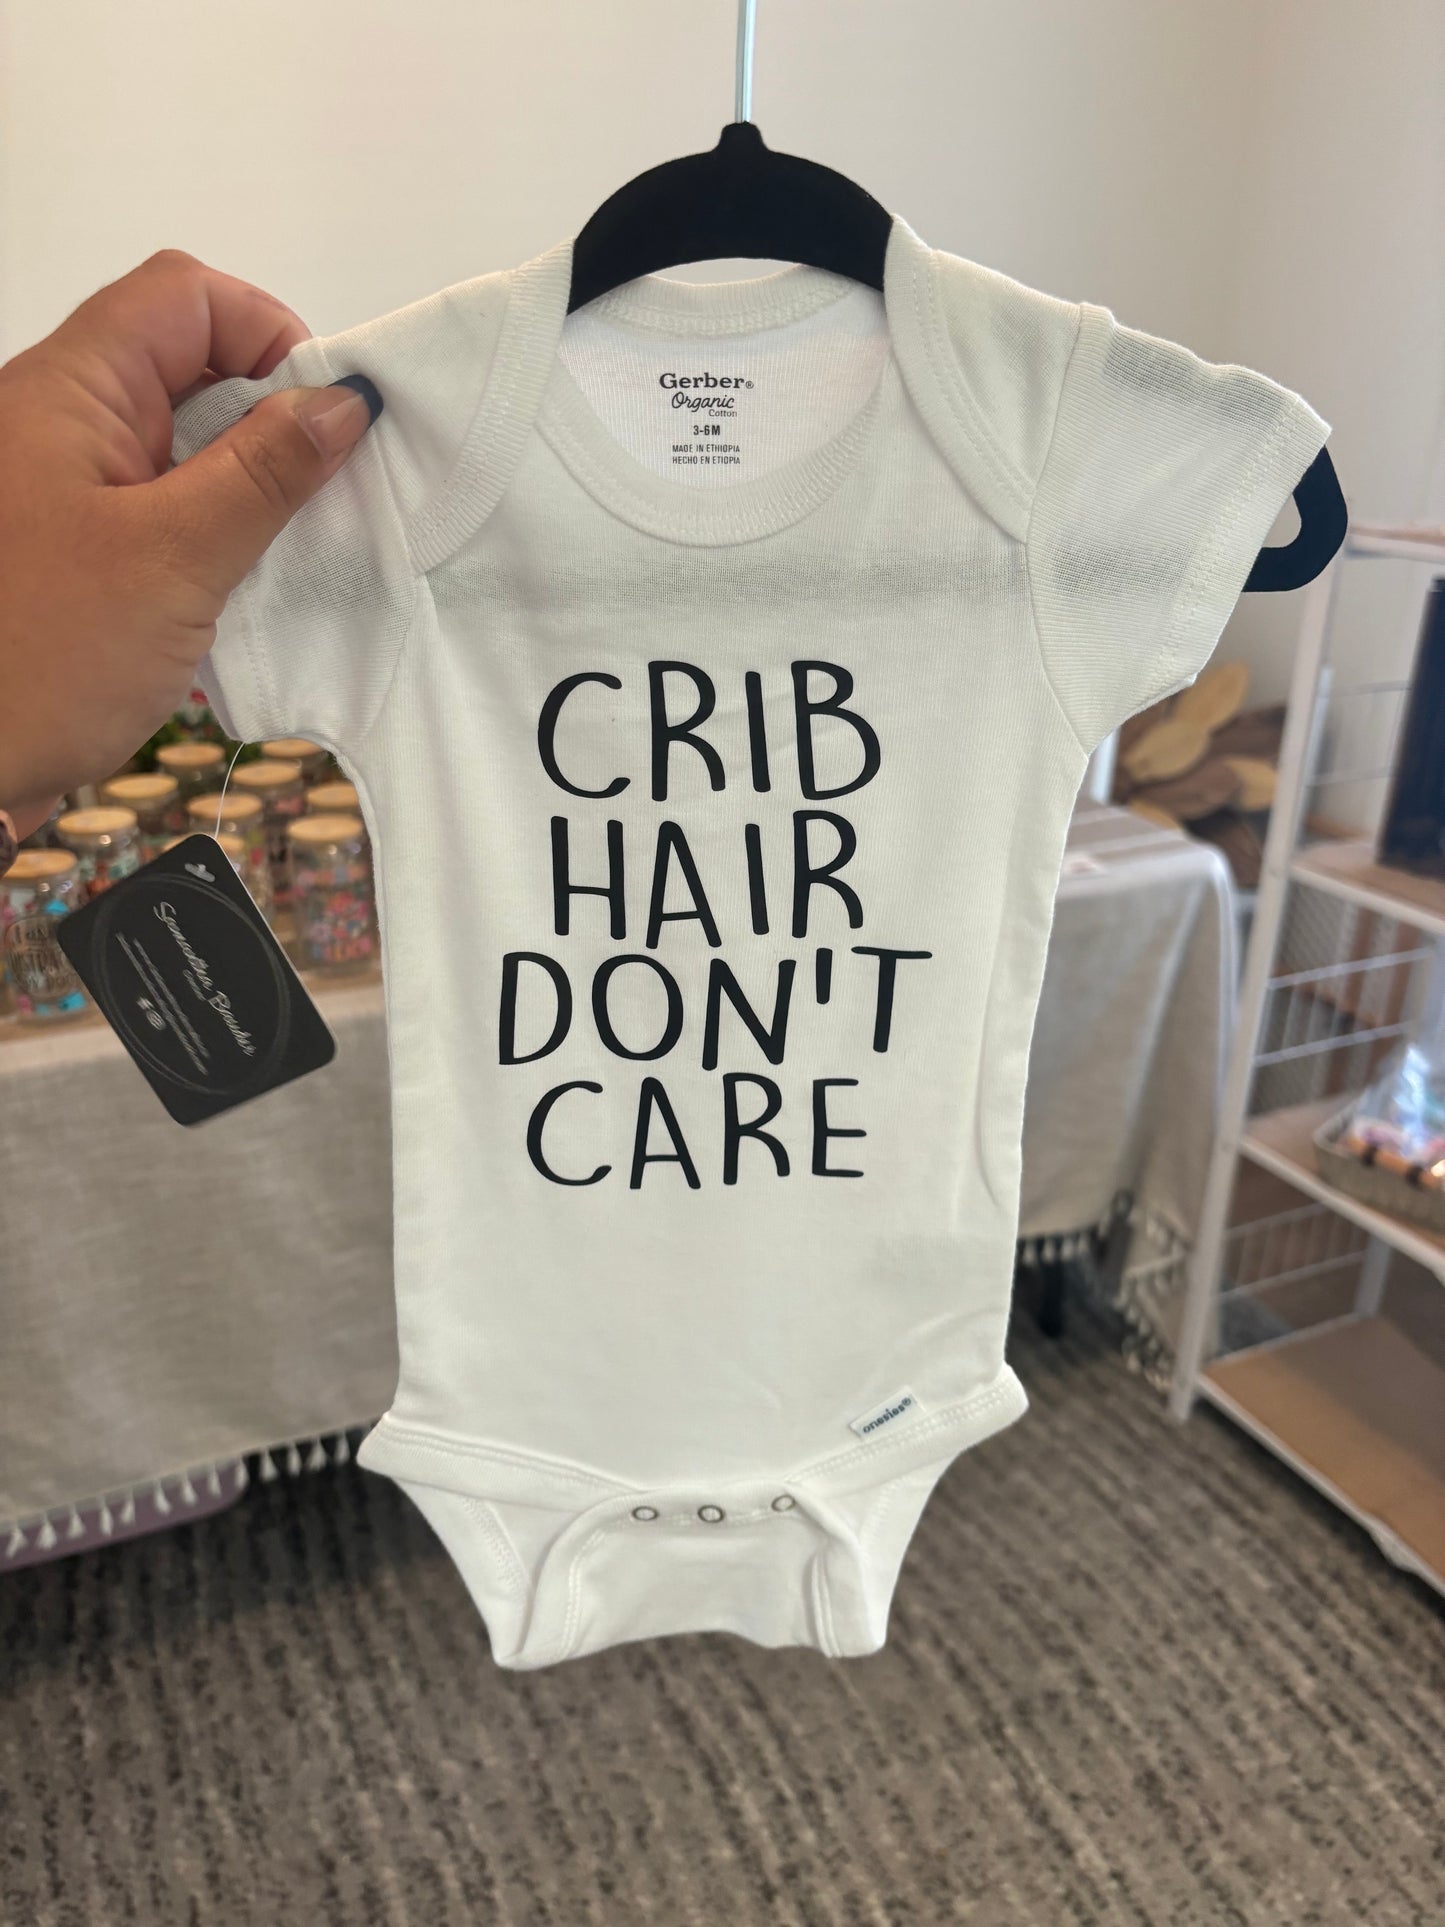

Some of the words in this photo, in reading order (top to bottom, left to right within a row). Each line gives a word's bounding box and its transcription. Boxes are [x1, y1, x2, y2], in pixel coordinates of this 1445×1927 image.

[671, 391, 735, 412] Organic
[708, 409, 738, 418] Cotton
[693, 425, 721, 436] 3-6M
[672, 444, 694, 453] MADE
[696, 444, 704, 453] IN
[706, 443, 740, 453] ETHIOPIA
[672, 456, 698, 465] HECHO
[700, 456, 710, 465] EN
[712, 455, 740, 465] ETIOPIA
[537, 660, 881, 802] CRIB
[550, 809, 864, 950] HAIR
[498, 946, 933, 1072] DON'T
[526, 1072, 867, 1190] CARE
